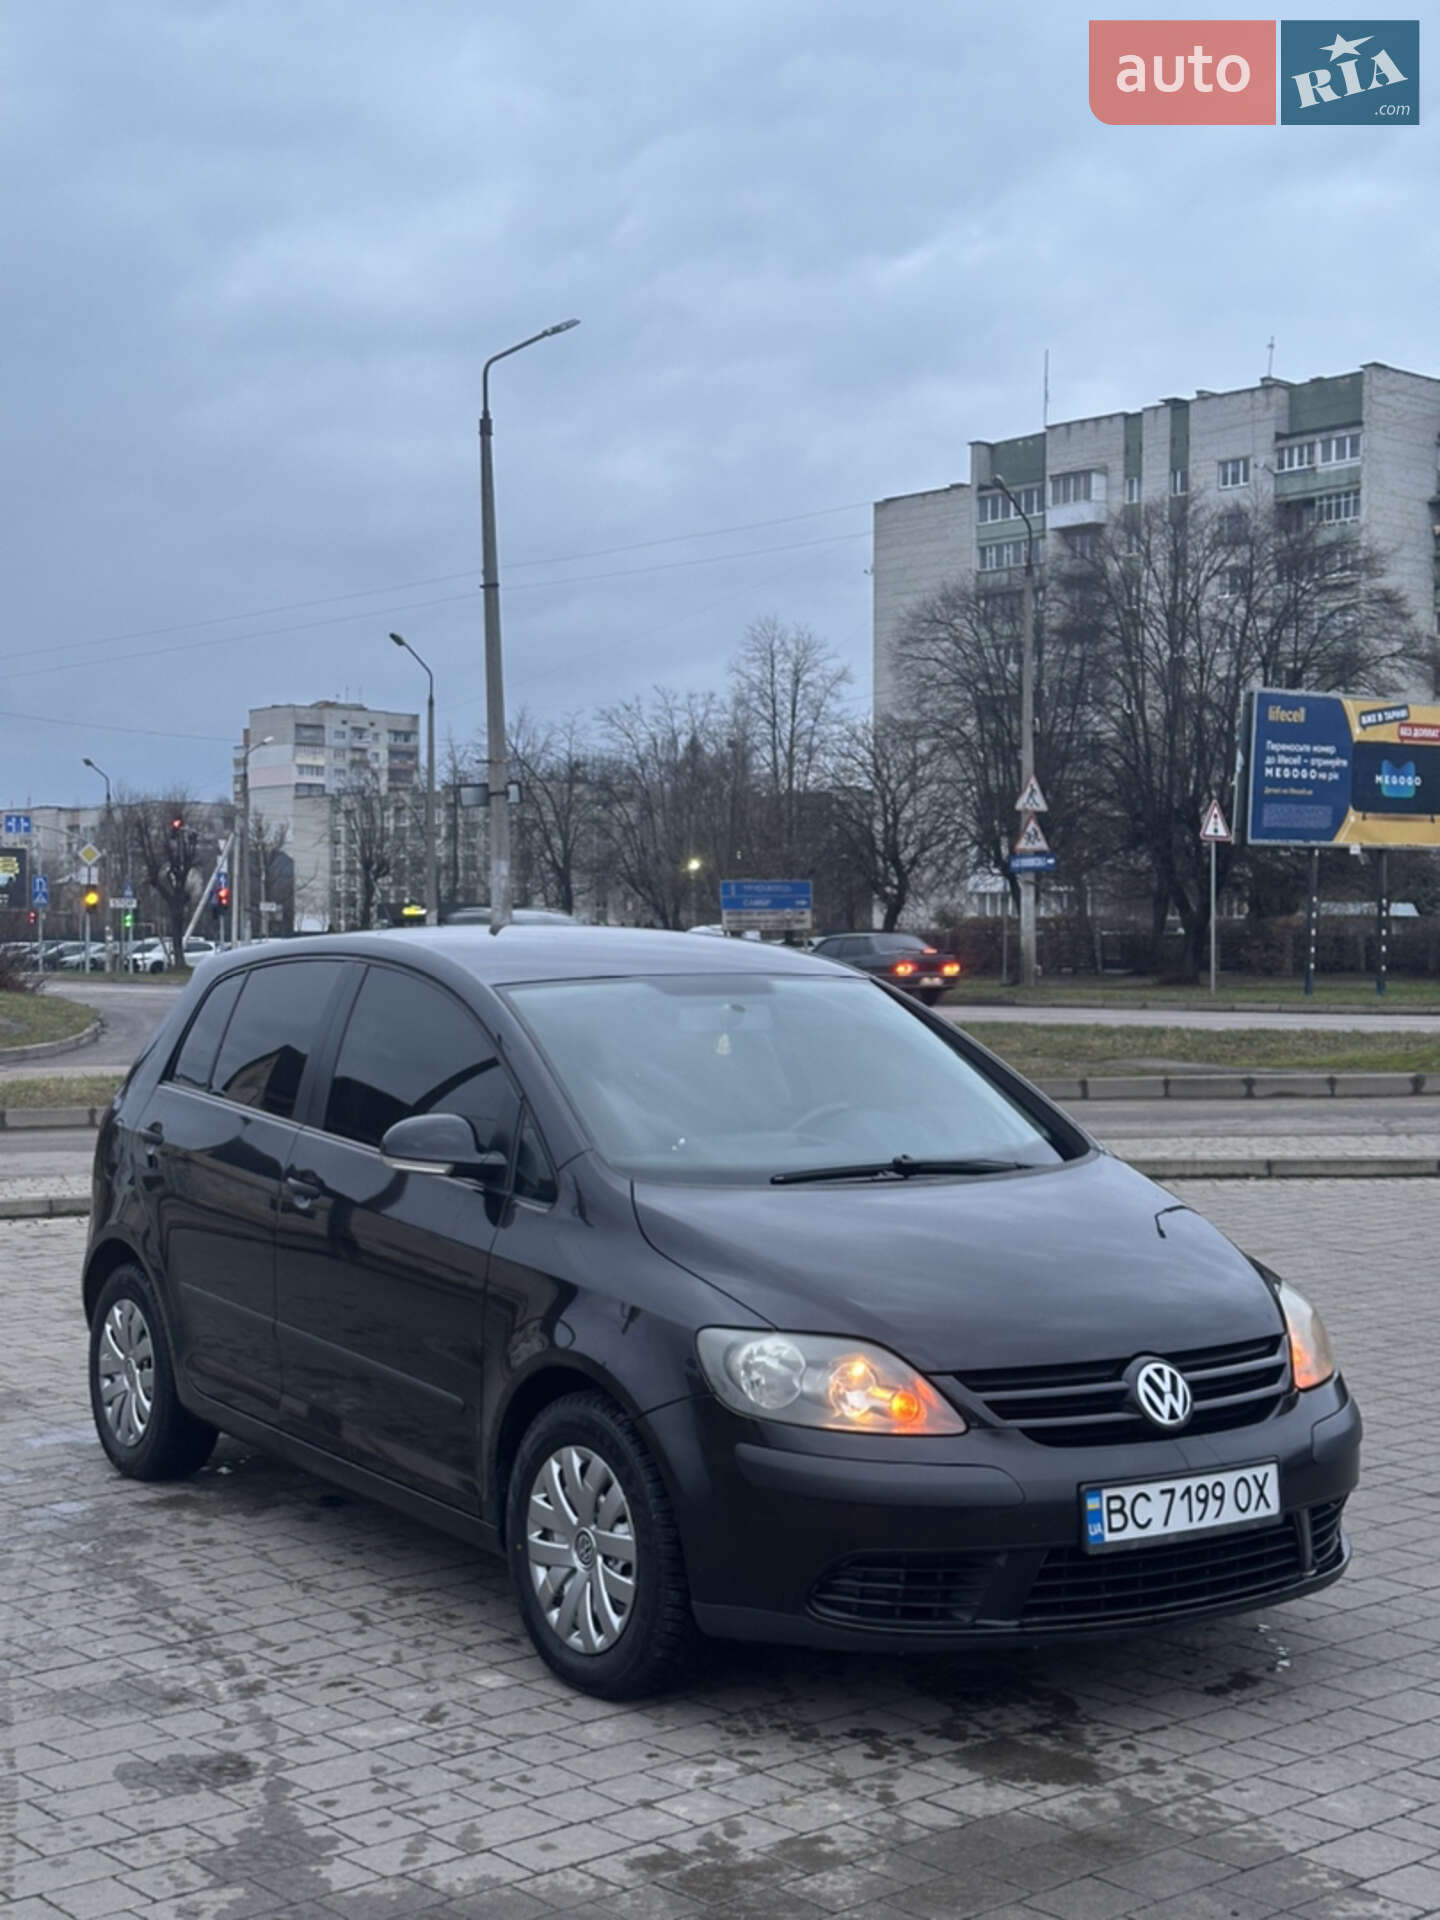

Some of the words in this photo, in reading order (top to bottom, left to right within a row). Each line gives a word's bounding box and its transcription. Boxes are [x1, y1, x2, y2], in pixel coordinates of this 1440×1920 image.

[1268, 705, 1306, 723] lifecell
[1265, 767, 1318, 780] MEGOGO
[1375, 774, 1422, 786] MEGOGO
[1159, 1481, 1226, 1527] 7199
